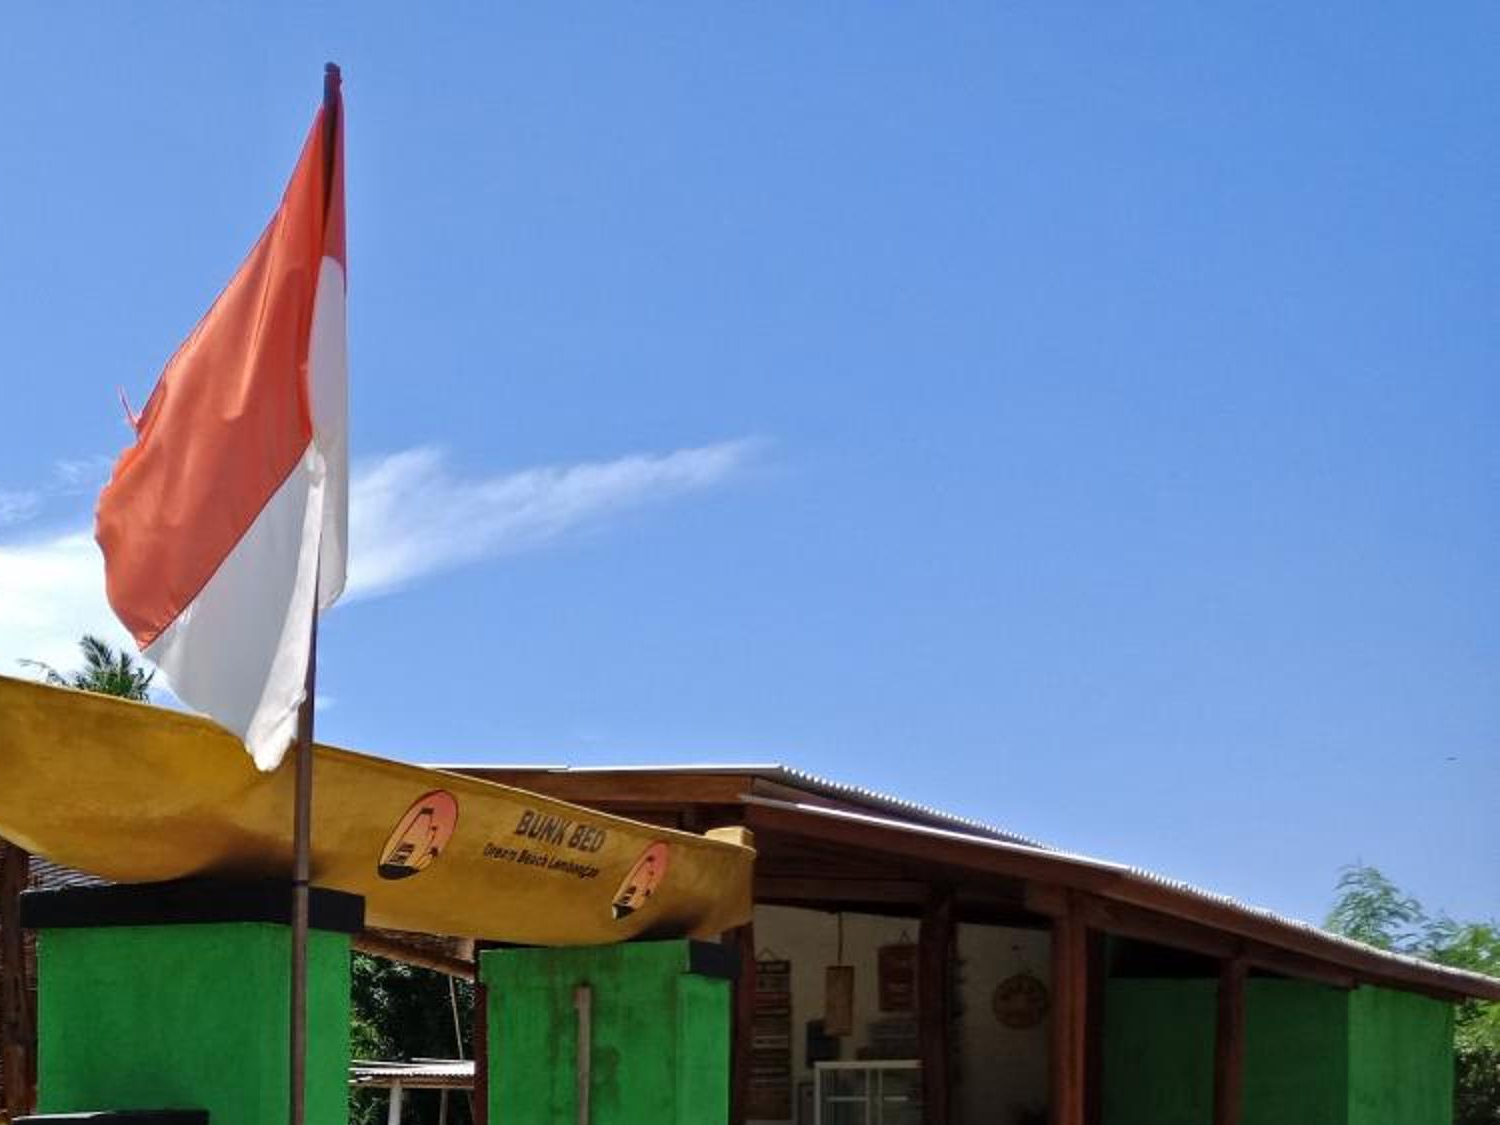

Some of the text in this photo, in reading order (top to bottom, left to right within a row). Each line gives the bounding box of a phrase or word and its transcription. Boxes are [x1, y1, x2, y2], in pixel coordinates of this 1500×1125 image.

[514, 809, 606, 853] BUNK BED
[516, 849, 548, 867] Beach
